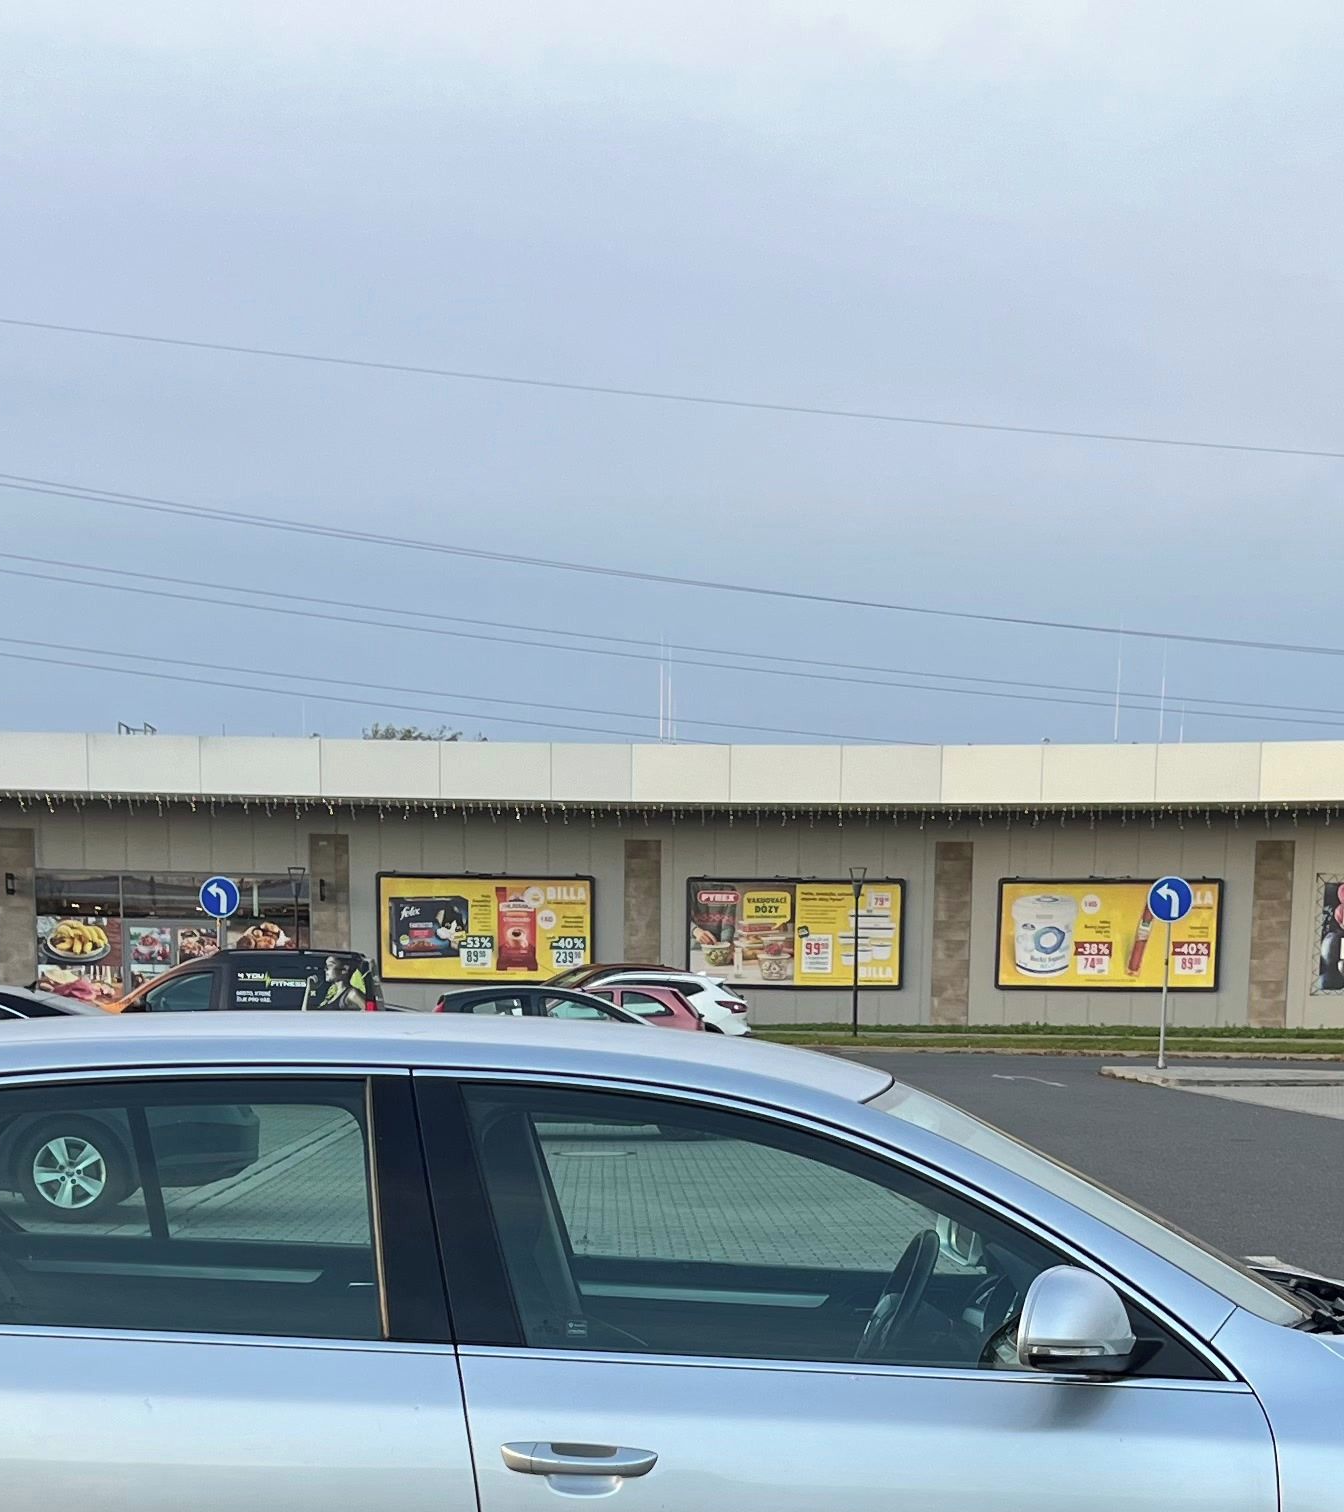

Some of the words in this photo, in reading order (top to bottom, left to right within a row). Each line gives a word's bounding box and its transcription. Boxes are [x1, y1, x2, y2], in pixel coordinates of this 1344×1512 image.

[546, 886, 586, 900] BILLA
[400, 905, 421, 921] felix
[460, 936, 492, 949] -53%
[552, 938, 585, 949] -40%
[1077, 943, 1110, 955] -38%
[1174, 943, 1209, 955] -40%
[859, 966, 894, 978] BILLA
